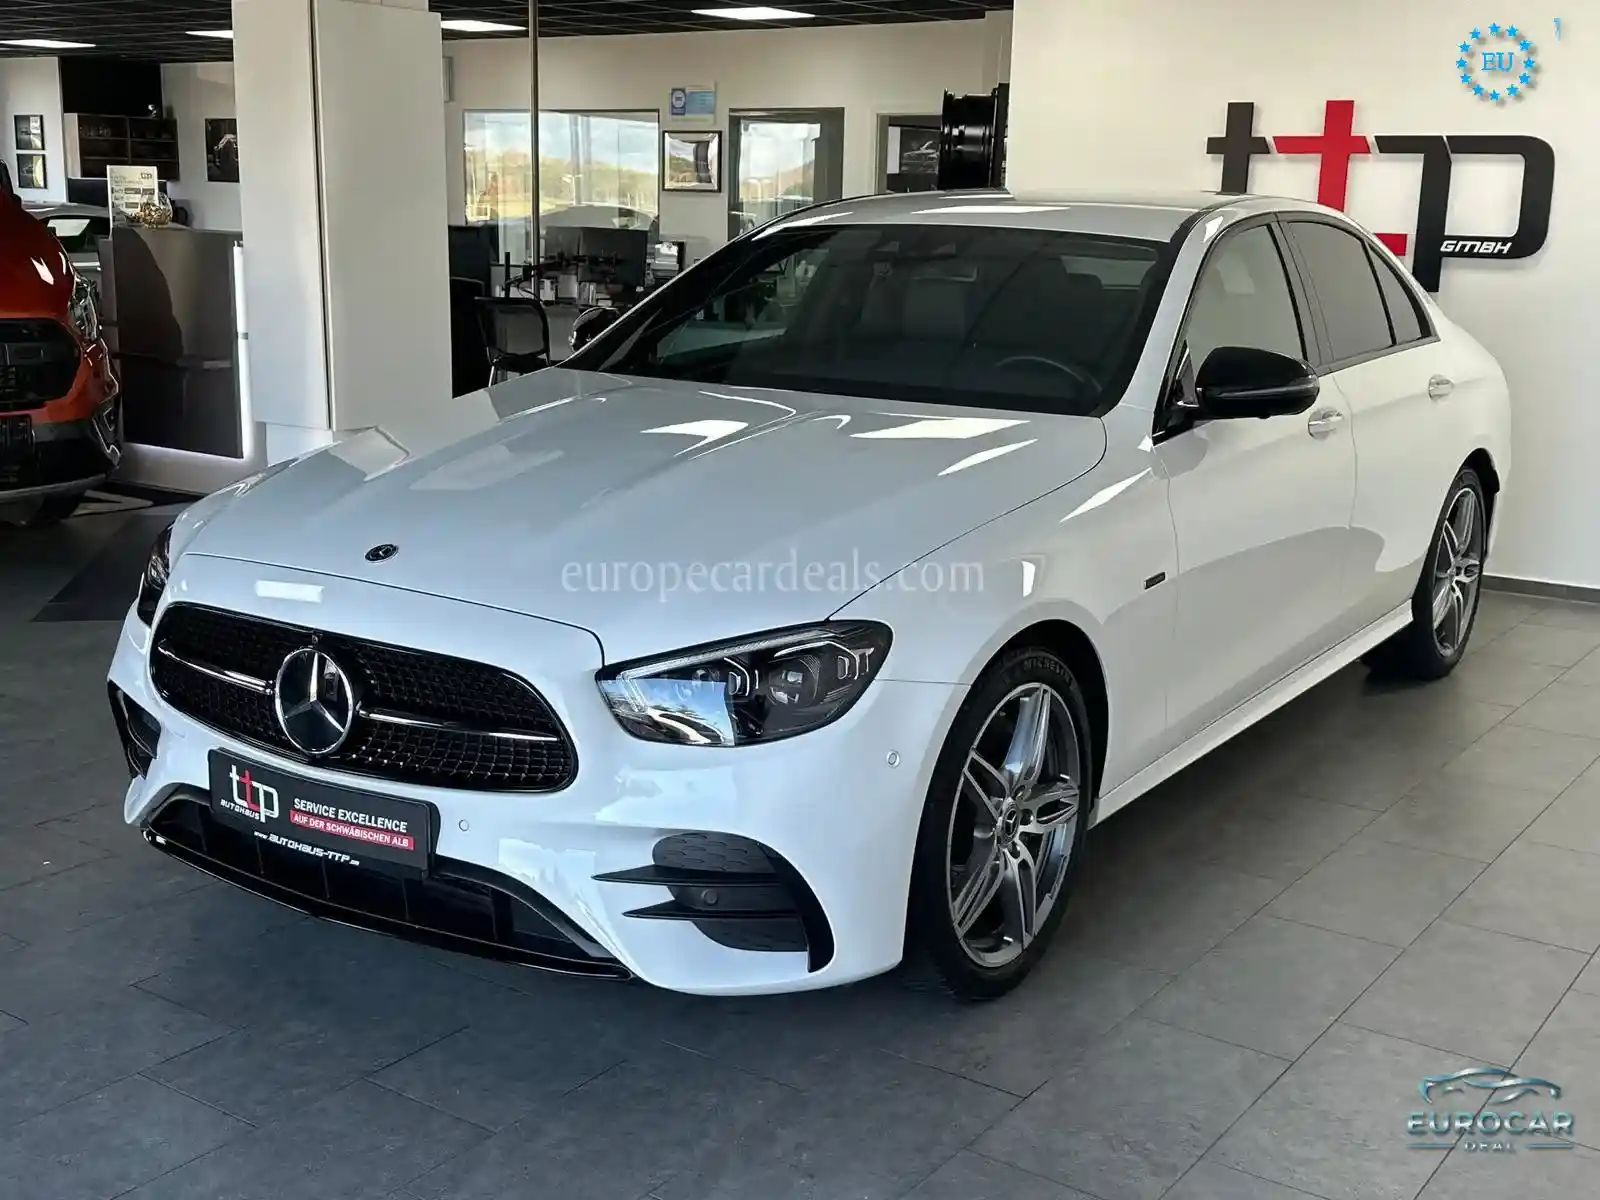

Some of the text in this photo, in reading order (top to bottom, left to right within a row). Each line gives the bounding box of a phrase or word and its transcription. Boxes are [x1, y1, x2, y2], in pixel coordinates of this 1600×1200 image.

[293, 797, 408, 833] SERVICE EXCELLENCE
[294, 813, 409, 847] AUF DER SCHWÄBISCHEN ALB
